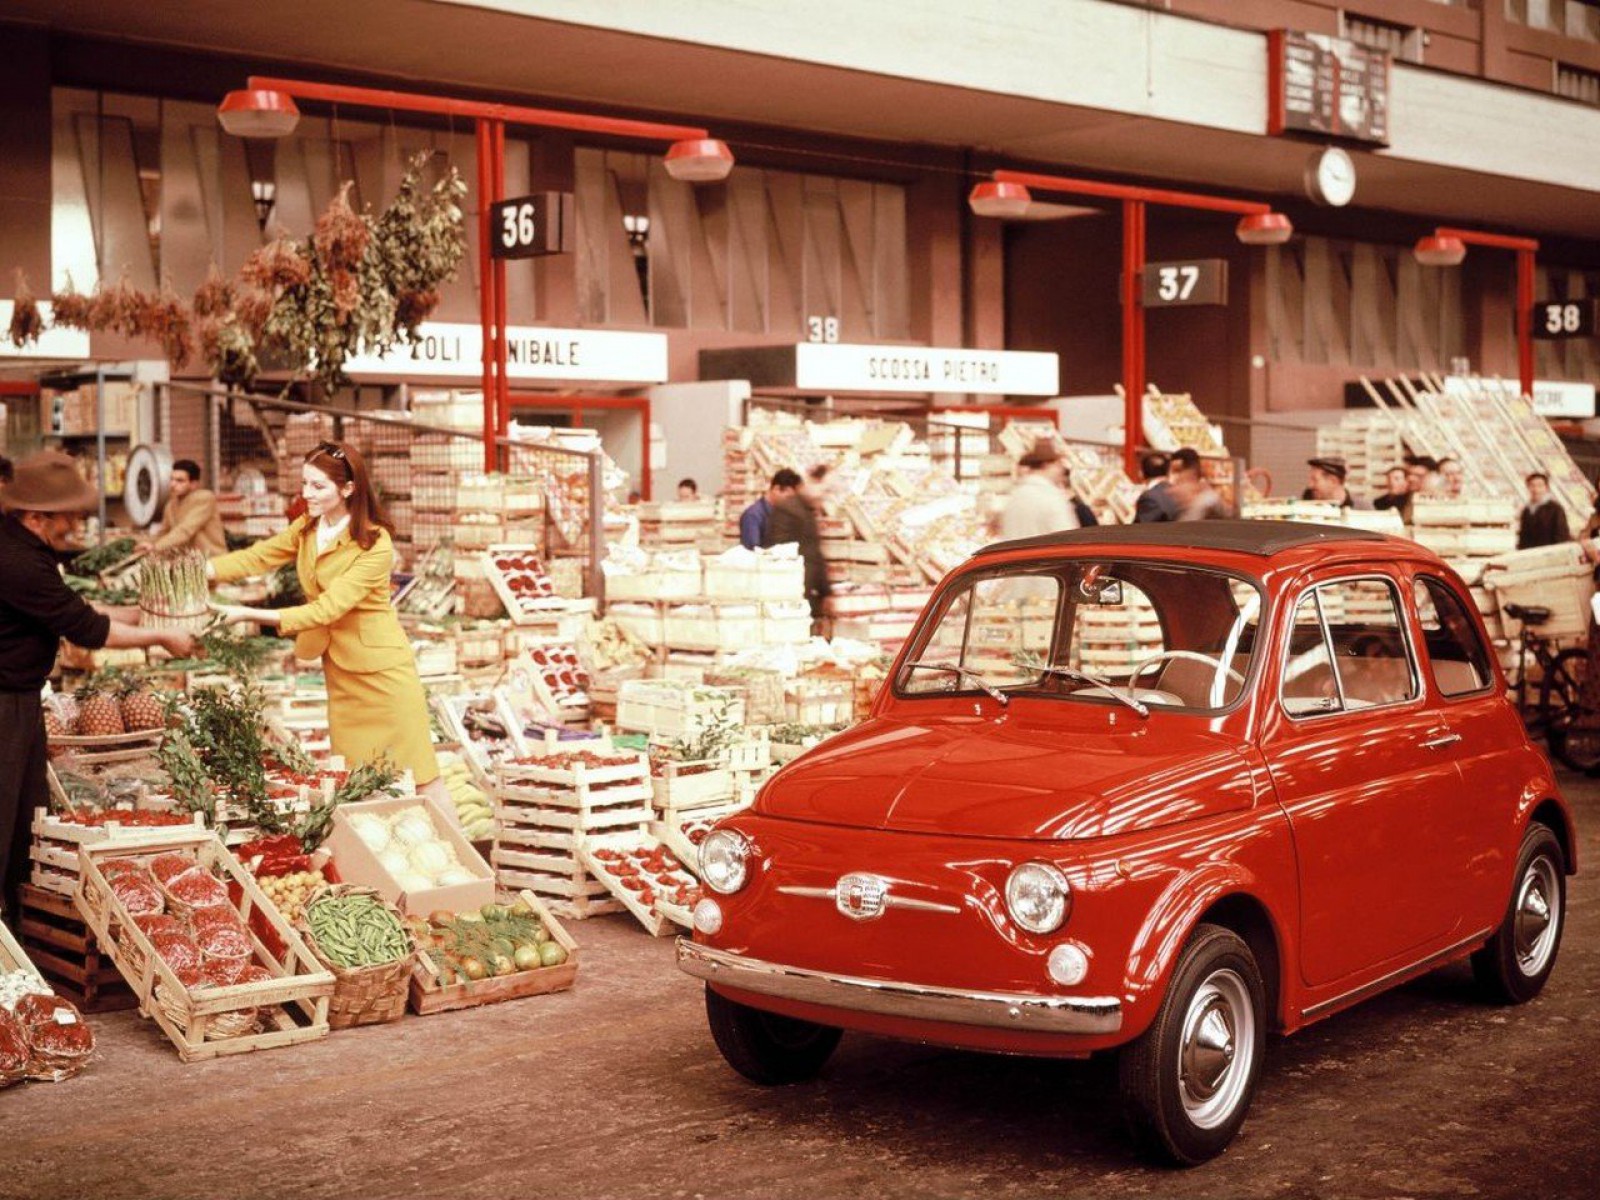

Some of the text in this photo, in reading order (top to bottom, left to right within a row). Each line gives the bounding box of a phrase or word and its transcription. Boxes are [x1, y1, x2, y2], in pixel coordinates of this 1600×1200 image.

[502, 204, 535, 247] 36
[1159, 266, 1199, 301] 37
[808, 315, 839, 343] 38
[1546, 304, 1580, 334] 38
[481, 338, 580, 366] NIBALE
[869, 357, 998, 382] SCOSSA PIETRO
